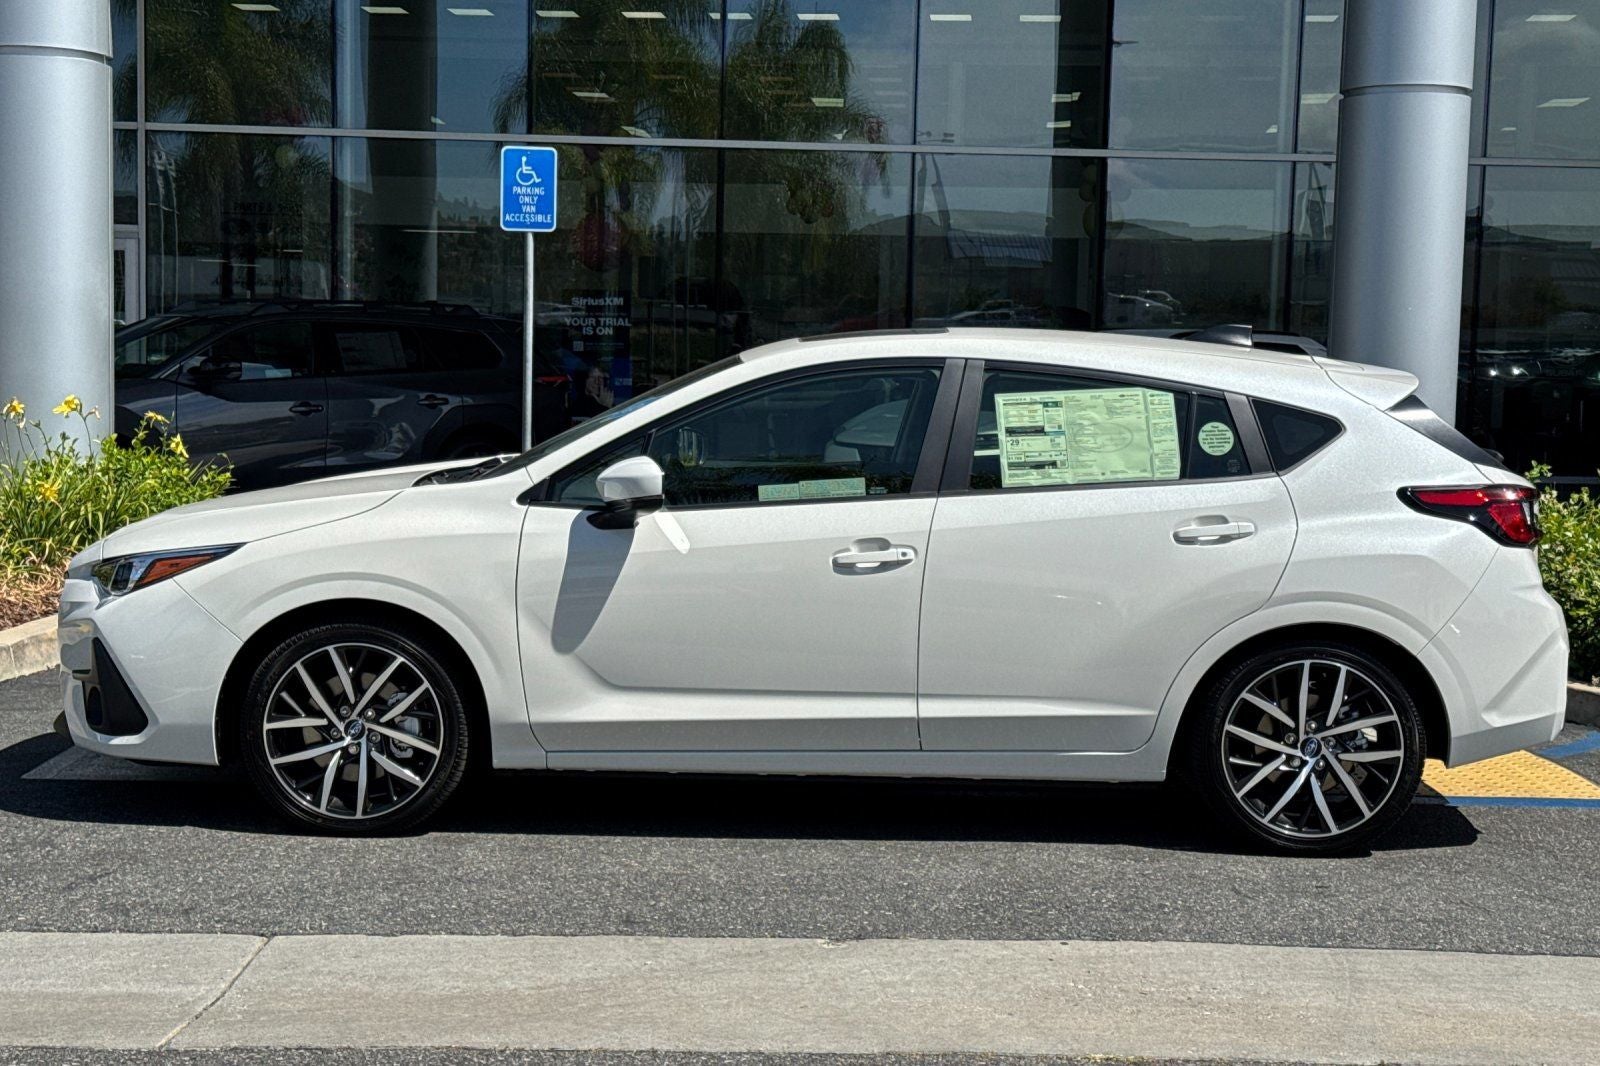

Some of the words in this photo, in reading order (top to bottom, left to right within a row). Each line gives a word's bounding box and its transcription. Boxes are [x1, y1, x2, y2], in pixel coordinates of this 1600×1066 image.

[512, 186, 545, 195] PARKING
[519, 195, 539, 204] ONLY
[521, 204, 536, 213] VAN
[505, 213, 552, 223] ACCESSIBLE
[571, 297, 624, 306] SiriusXM
[564, 317, 597, 327] YOUR
[598, 317, 632, 327] TRIAL
[582, 326, 594, 335] IS
[596, 326, 613, 335] ON
